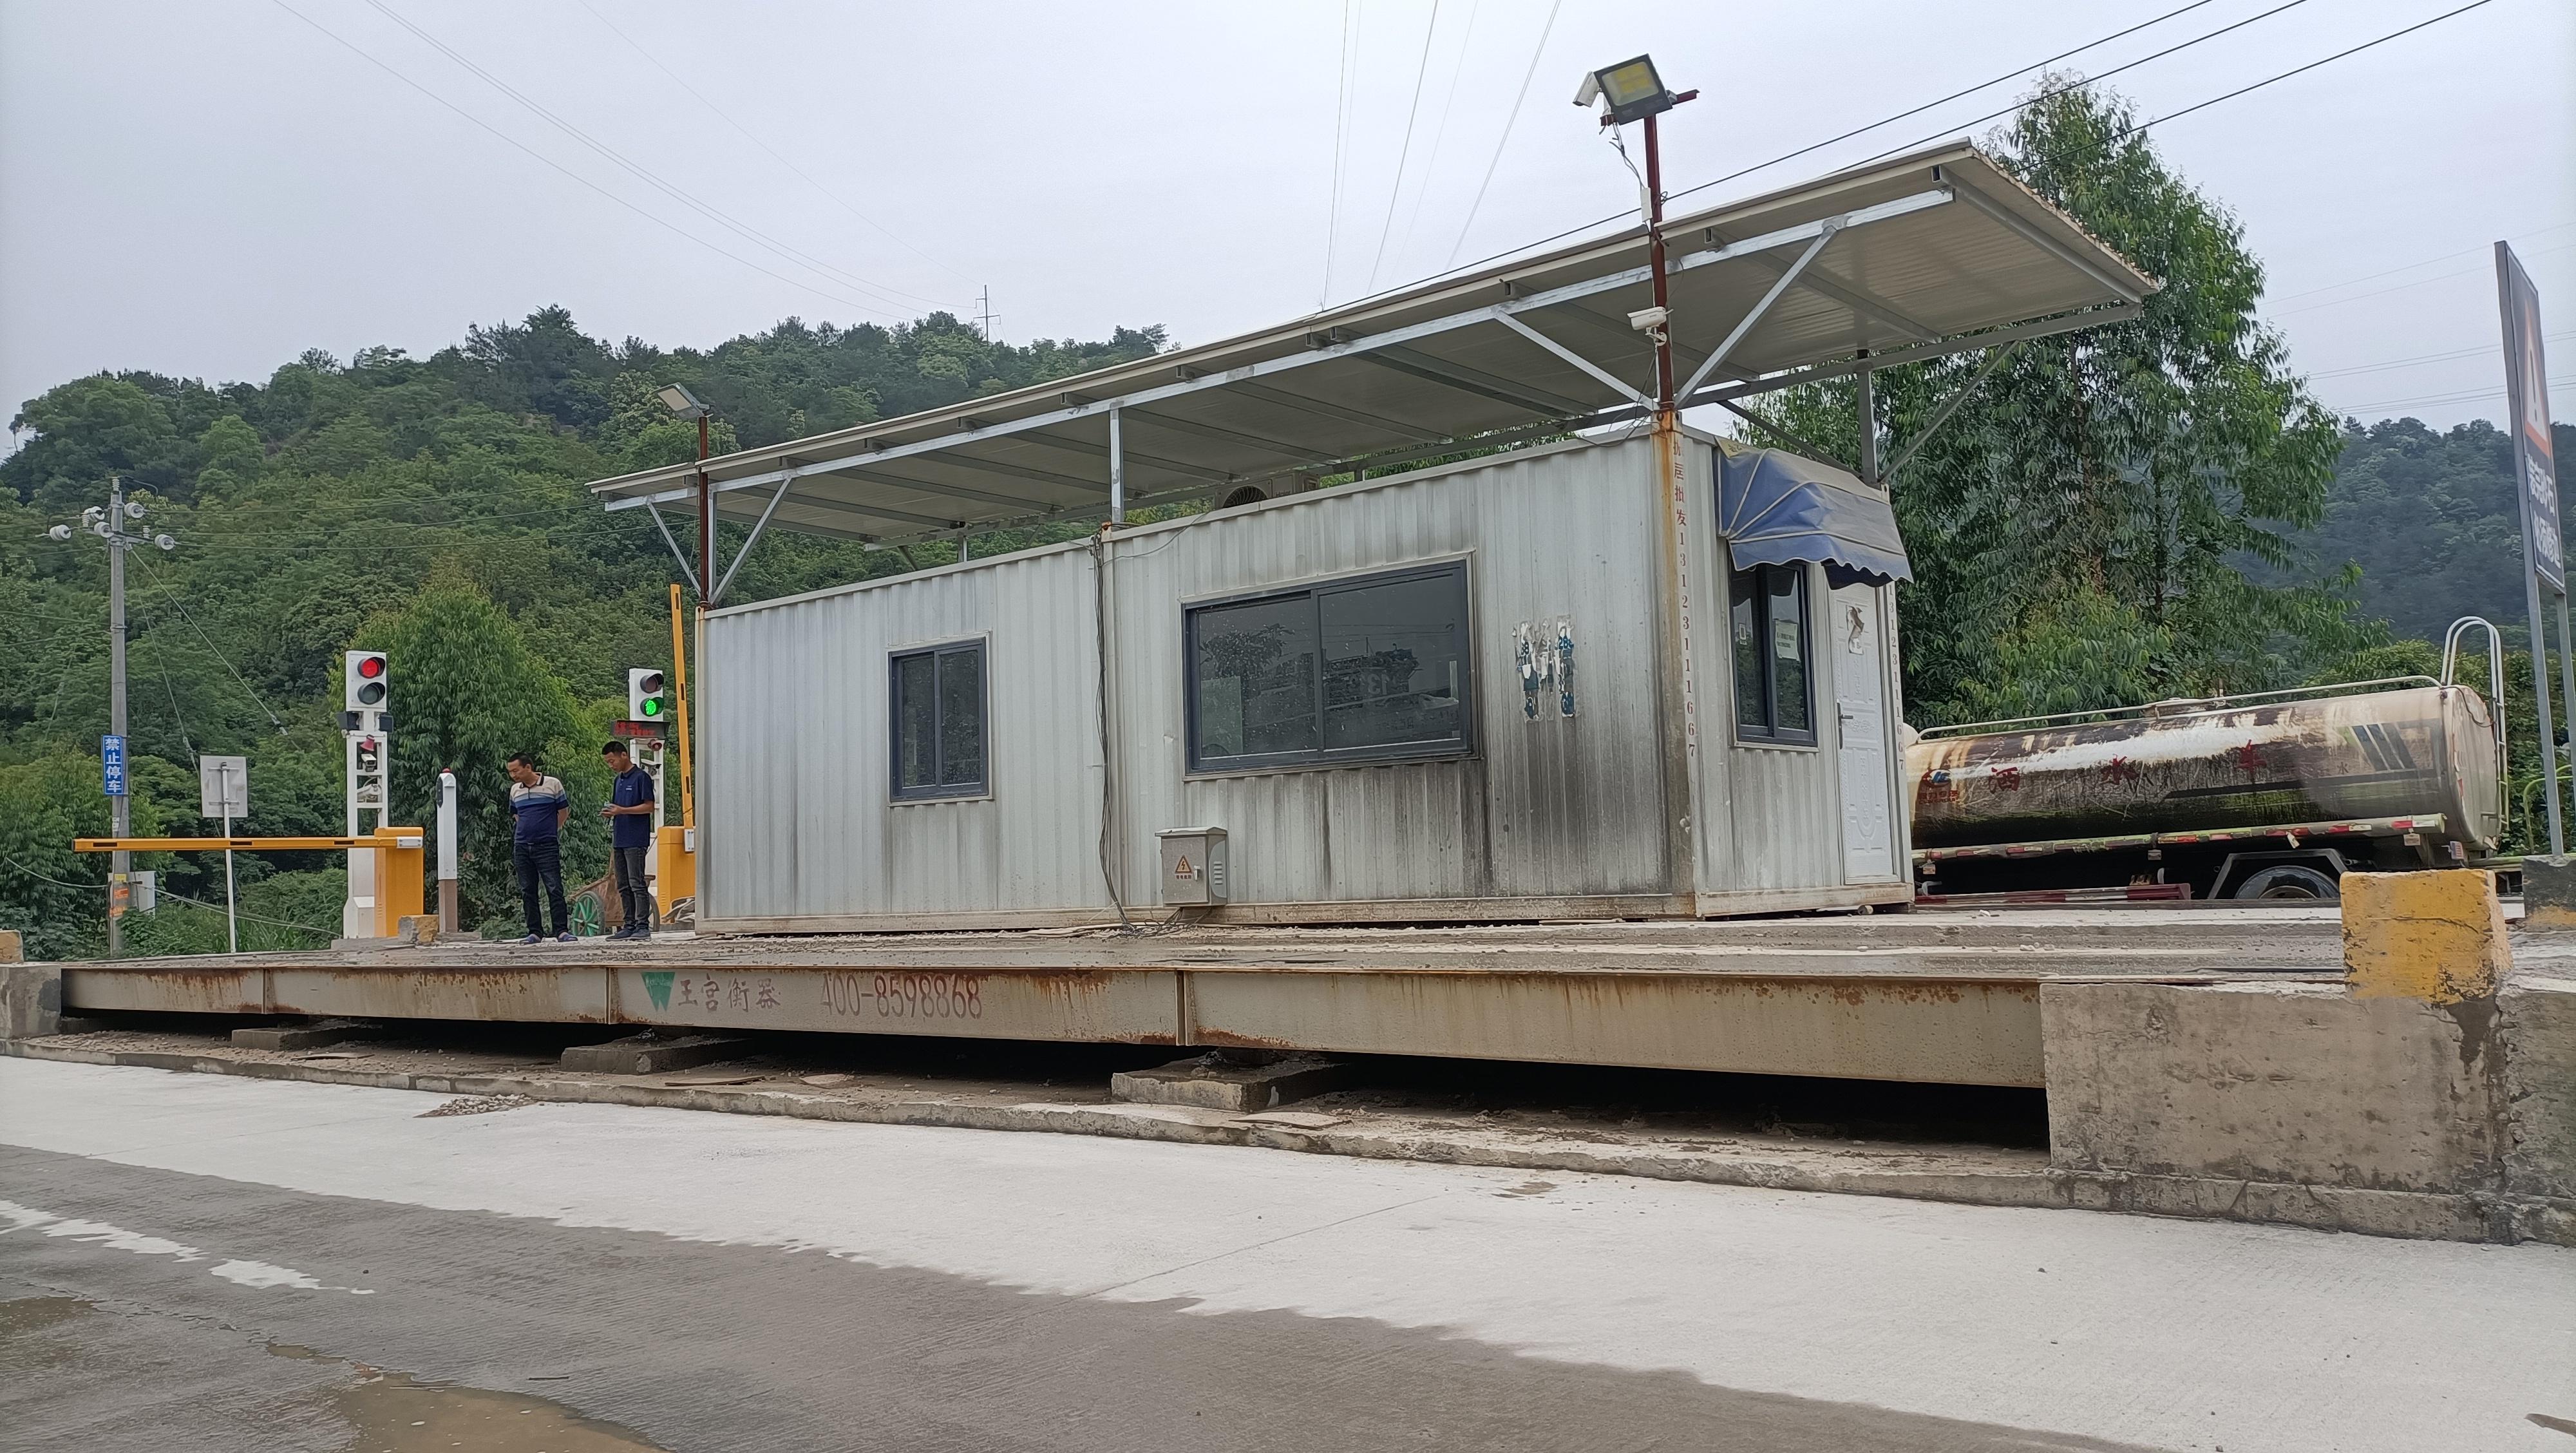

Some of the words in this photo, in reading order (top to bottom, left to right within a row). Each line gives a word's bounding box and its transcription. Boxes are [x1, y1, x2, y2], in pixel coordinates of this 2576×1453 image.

[105, 737, 122, 793] 禁止停车
[678, 973, 781, 1012] 王宫衡器
[820, 973, 982, 1020] 400-8598868
